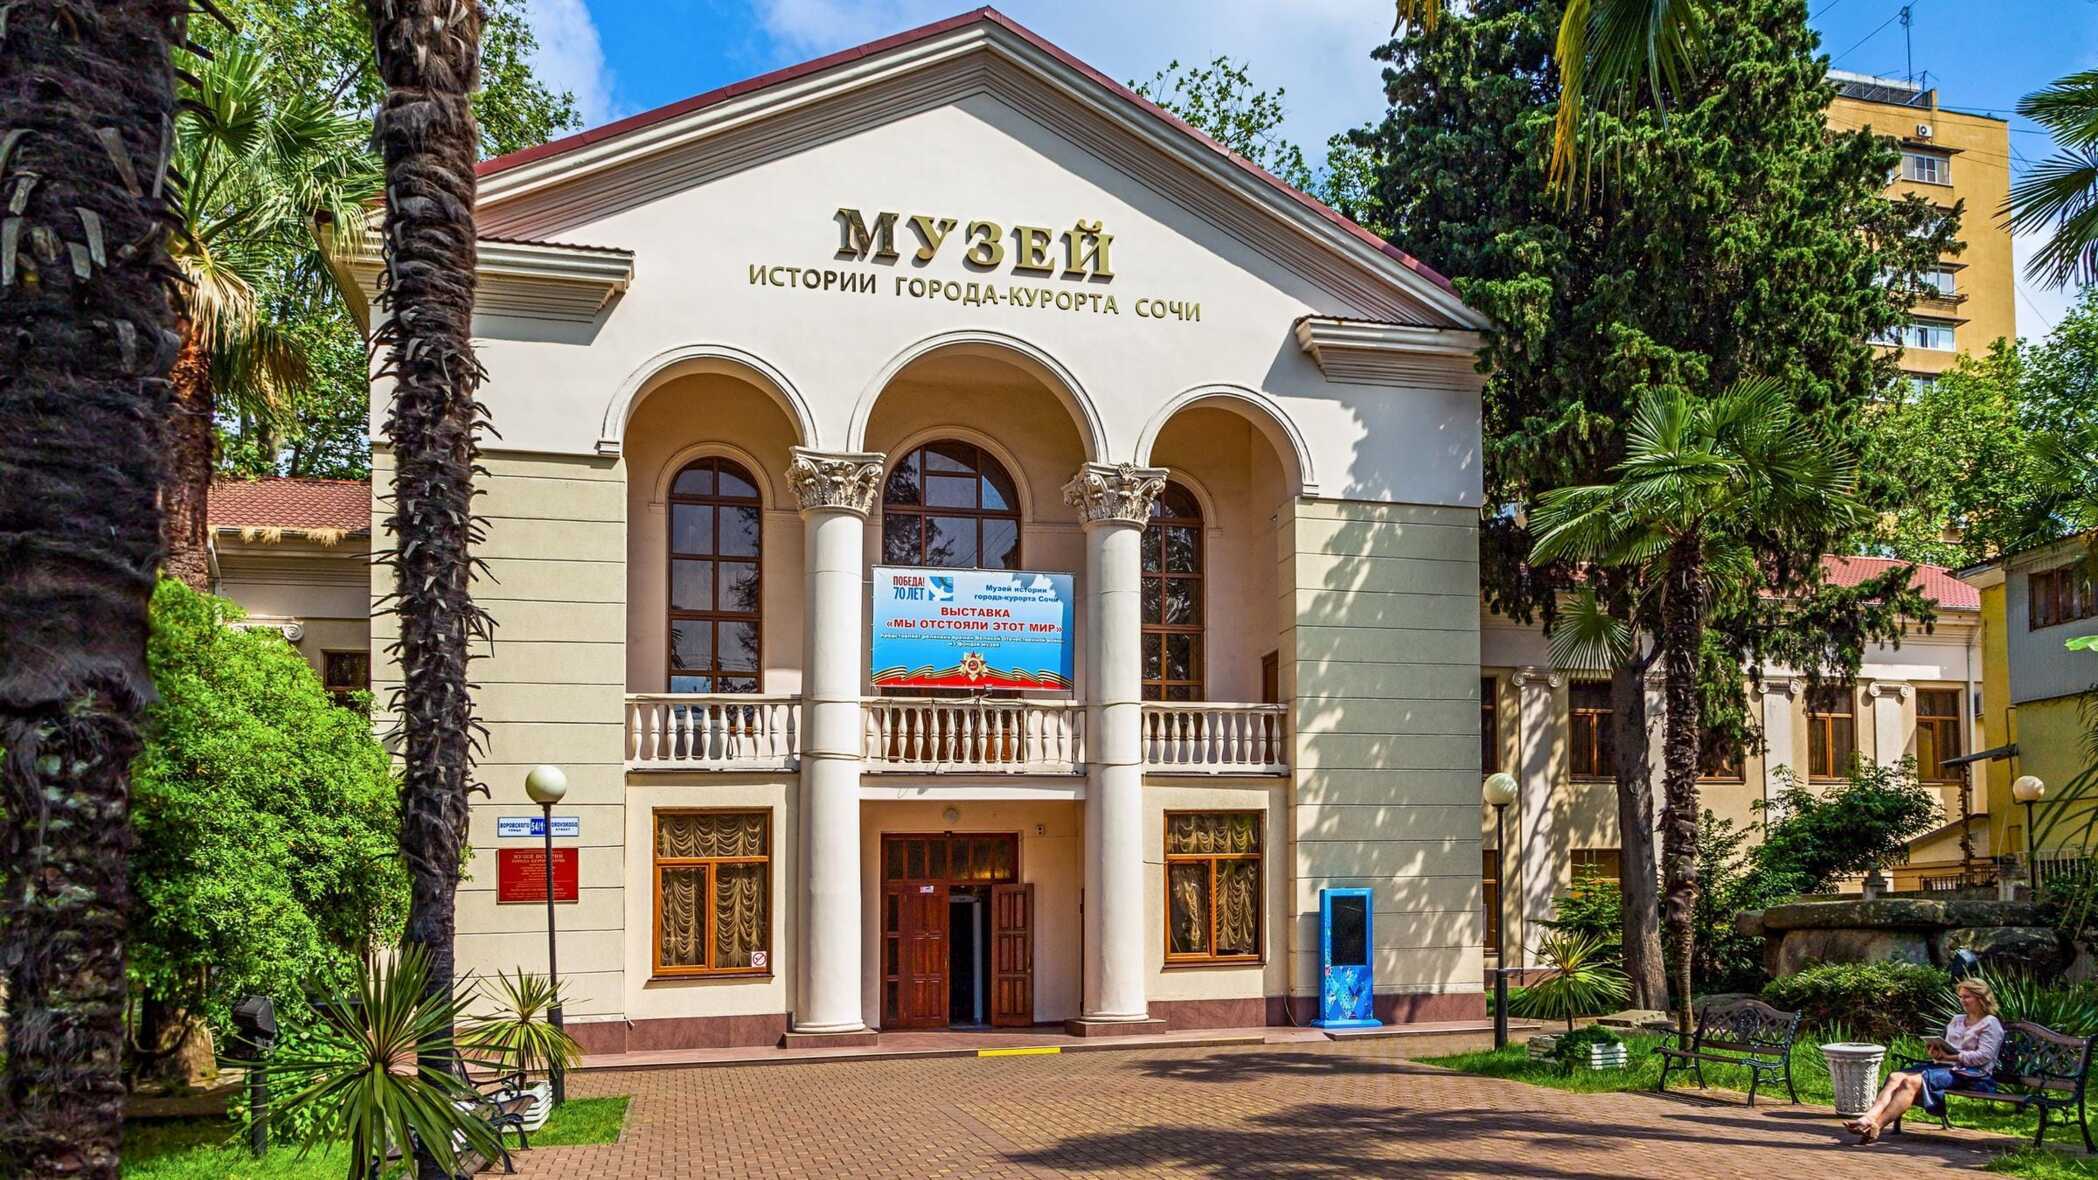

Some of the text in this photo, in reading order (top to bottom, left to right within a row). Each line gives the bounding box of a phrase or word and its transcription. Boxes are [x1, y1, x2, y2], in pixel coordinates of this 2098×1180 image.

[833, 208, 1115, 281] МУЗЕЙ
[749, 264, 1201, 322] ИСТОРИИ ГОРОДА-КУРОРТА СОЧИ
[892, 575, 925, 587] ПОБЕДА!
[893, 588, 924, 600] 70 ЛЕТ
[941, 607, 1010, 618] ВЫСТАВКА
[886, 620, 1063, 633] «МЫ ОТСТОЯЛИ ЭТОТ МИР»
